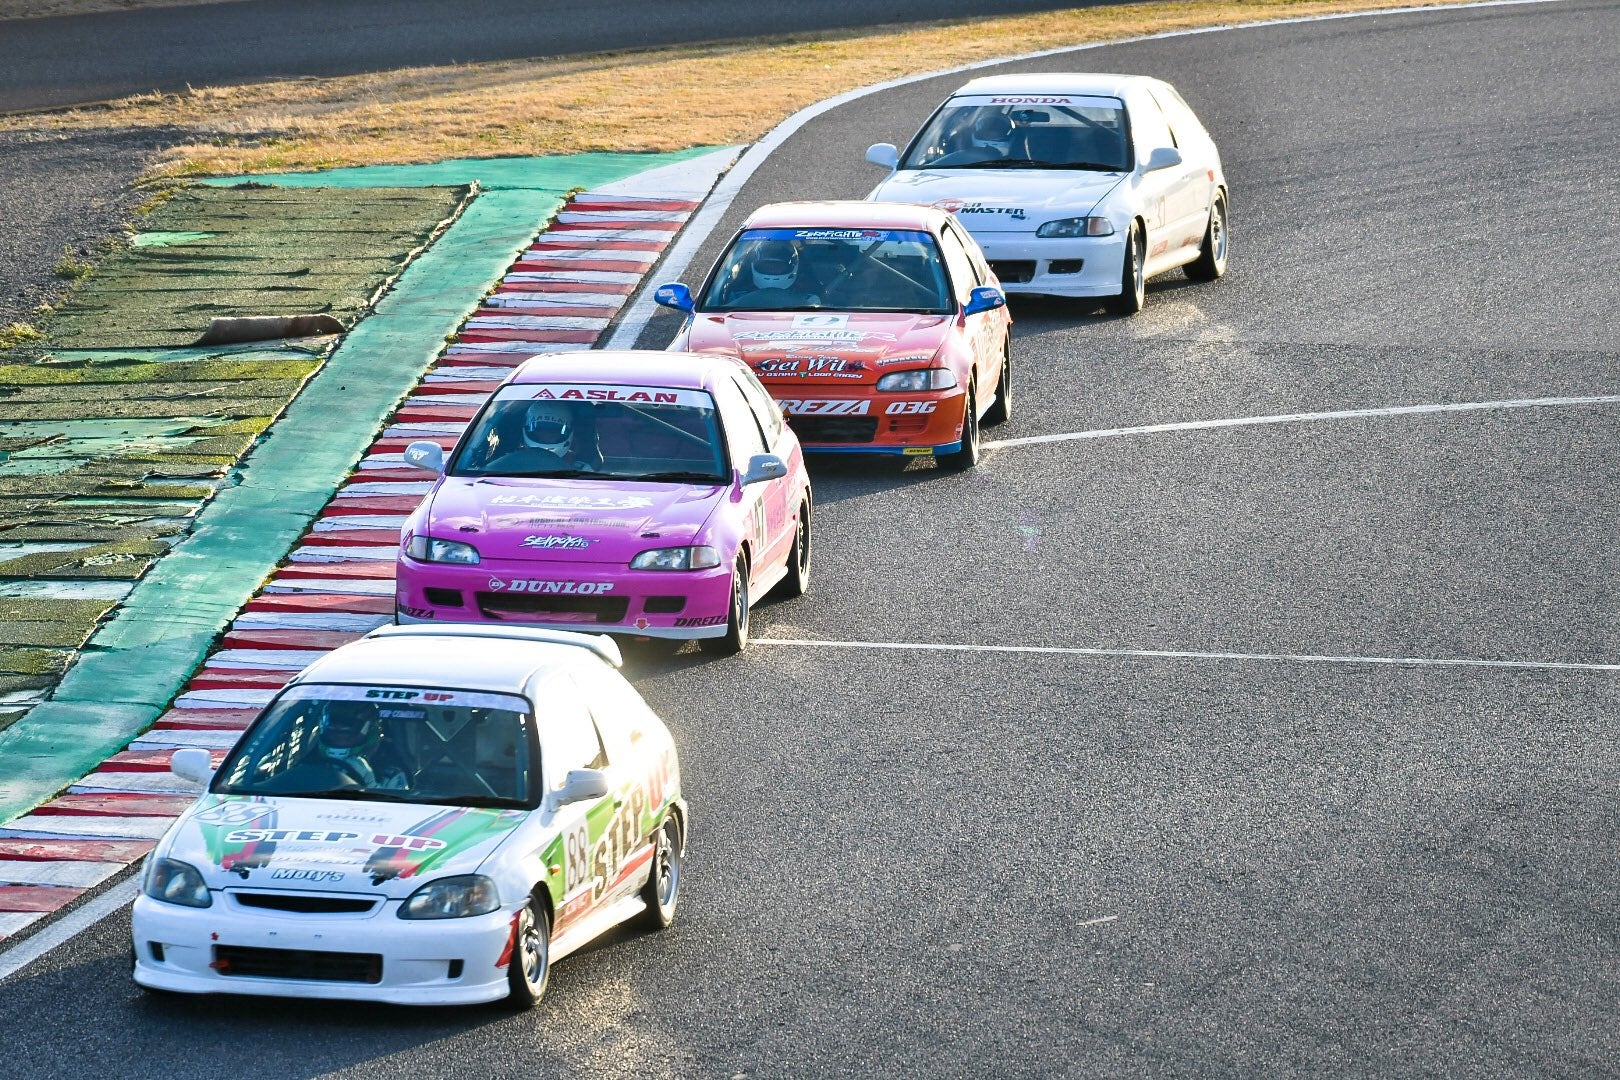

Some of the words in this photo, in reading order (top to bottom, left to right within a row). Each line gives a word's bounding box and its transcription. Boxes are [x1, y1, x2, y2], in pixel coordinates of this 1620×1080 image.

[960, 207, 1025, 216] MASTER
[760, 359, 800, 372] Get
[560, 388, 678, 404] ASLAN
[507, 579, 614, 595] DUNLOP
[366, 689, 420, 700] STEP
[424, 692, 454, 702] UP
[193, 803, 276, 823] 88
[225, 829, 361, 843] STEP
[369, 832, 449, 851] UP
[592, 784, 645, 901] STEP
[567, 825, 588, 892] 88
